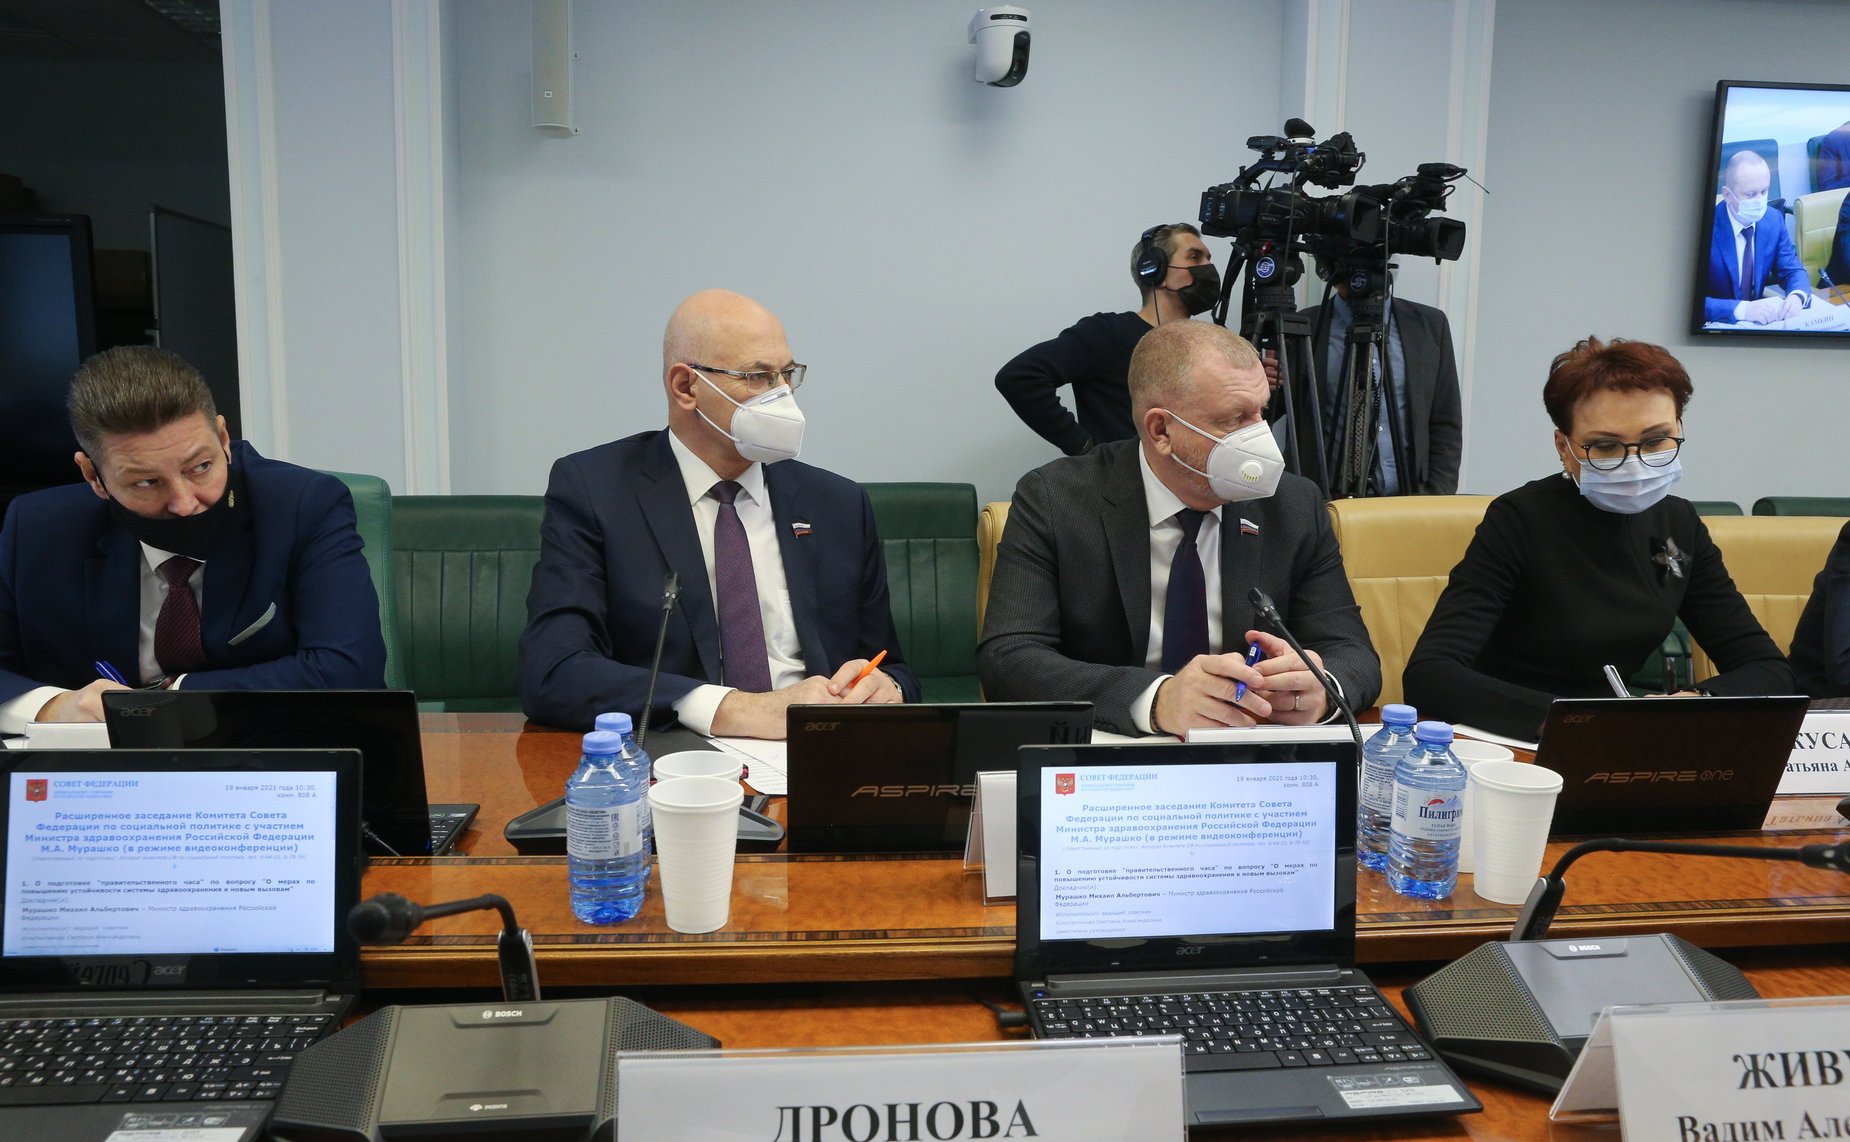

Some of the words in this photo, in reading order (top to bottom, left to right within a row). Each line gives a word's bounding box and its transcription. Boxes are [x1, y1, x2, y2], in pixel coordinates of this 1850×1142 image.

[1563, 714, 1596, 723] acer
[804, 721, 840, 731] acer
[1785, 762, 1838, 772] атьяна
[1108, 773, 1158, 781] ФЕДЕРАЦИИ
[1584, 771, 1698, 783] ASPIRE
[1700, 769, 1734, 782] one
[53, 780, 81, 788] СОВЕТ
[83, 780, 139, 788] ФЕДЕРАЦИИ
[851, 785, 980, 797] ASPIRE
[1082, 804, 1152, 812] Расширенное
[1154, 803, 1206, 811] заседание
[1210, 801, 1256, 809] Комитета
[1259, 800, 1292, 808] Совета
[55, 812, 131, 821] Расширенное
[134, 812, 192, 821] заседание
[195, 811, 246, 819] Комитета
[250, 811, 287, 819] Совета
[1065, 815, 1124, 823] Федерации
[1142, 813, 1202, 821] социальной
[1205, 812, 1251, 820] политике
[1262, 811, 1308, 819] участием
[36, 823, 99, 832] Федерации
[120, 822, 186, 831] социальной
[253, 823, 304, 831] участием
[1056, 825, 1106, 834] Министра
[1108, 824, 1198, 833] здравоохранения
[1201, 821, 1259, 830] Российской
[1262, 820, 1317, 829] Федерации
[25, 834, 80, 842] Министра
[83, 834, 182, 842] здравоохранения
[185, 832, 249, 841] Российской
[253, 833, 315, 842] Федерации
[1095, 834, 1142, 844] Мурашко
[1145, 833, 1155, 843] (в
[1158, 833, 1198, 842] режиме
[1201, 830, 1303, 841] видеоконференции)
[41, 845, 64, 853] М.А.
[68, 845, 119, 854] Мурашко
[123, 844, 134, 853] (в
[137, 845, 181, 853] режиме
[185, 844, 298, 853] видеоконференции)
[1116, 891, 1161, 899] Альбертович
[1176, 945, 1205, 955] acer
[154, 965, 187, 975] acer
[494, 1010, 523, 1018] BOSCH
[1732, 1049, 1850, 1090] ЖИВ
[1676, 1116, 1786, 1142] Вадим
